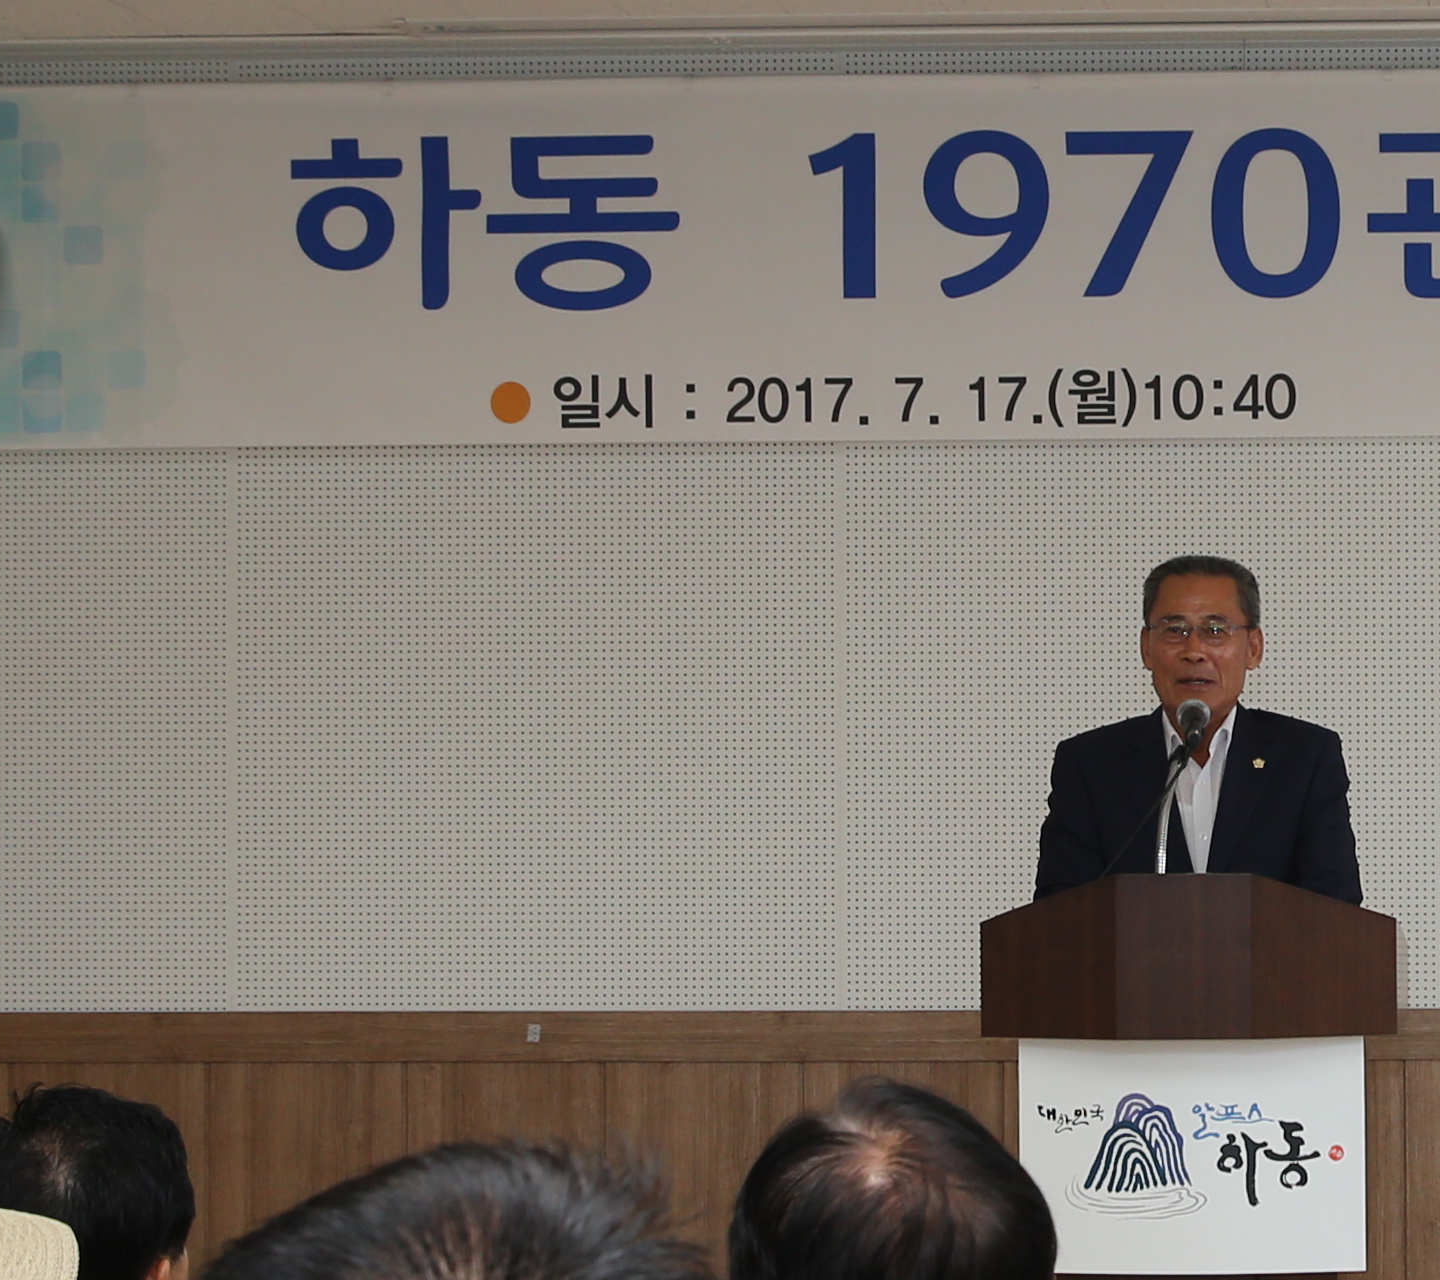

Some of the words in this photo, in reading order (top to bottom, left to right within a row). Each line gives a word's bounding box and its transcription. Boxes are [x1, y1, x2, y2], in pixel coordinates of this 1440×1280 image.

[290, 134, 681, 312] 하동
[552, 373, 654, 429] 일시
[725, 375, 869, 425] 2017.
[893, 375, 940, 425] 7.
[968, 367, 1297, 428] 17.(월)10:40
[1037, 1104, 1105, 1134] 대한민국
[1216, 1120, 1321, 1207] 하동
